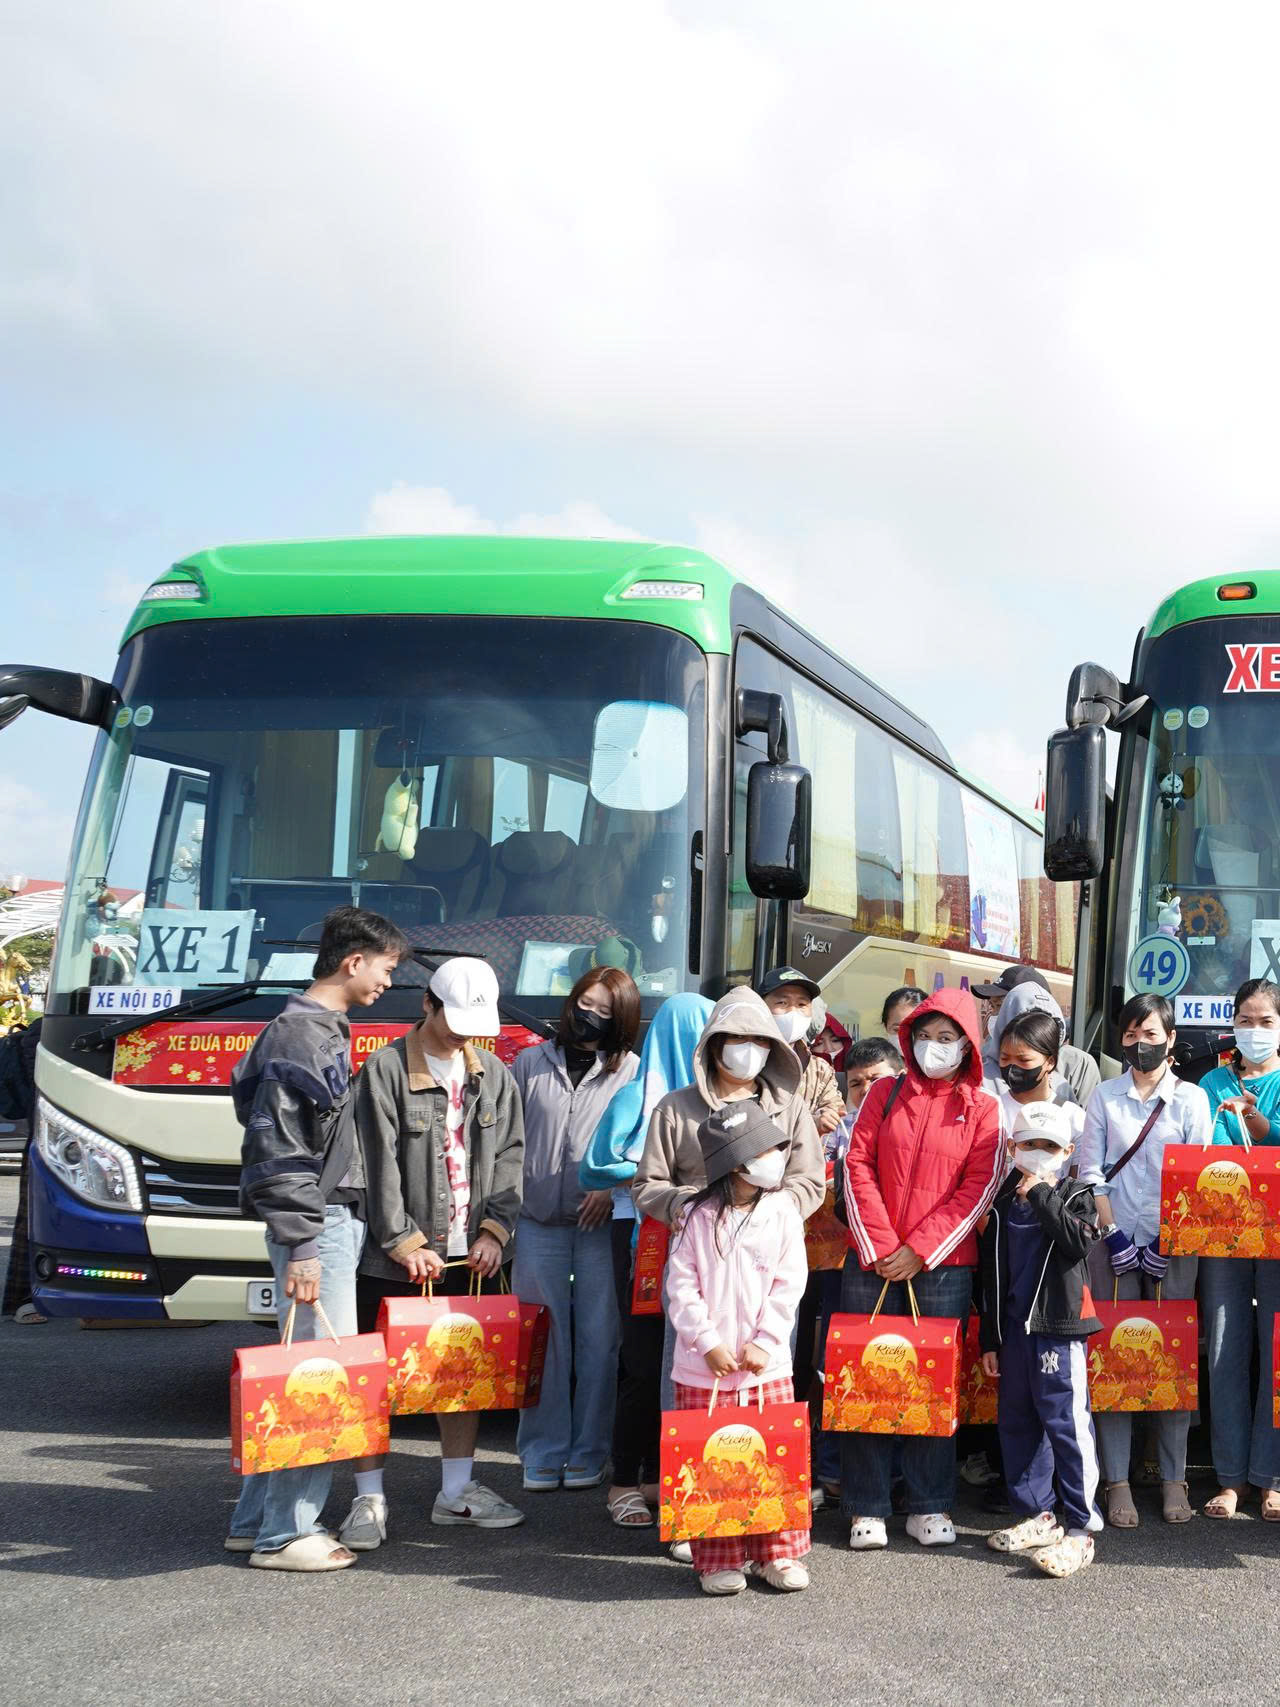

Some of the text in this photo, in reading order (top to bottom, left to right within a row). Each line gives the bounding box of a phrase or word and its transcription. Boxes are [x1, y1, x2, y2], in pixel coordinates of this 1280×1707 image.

[141, 925, 240, 973] XE 1
[1138, 951, 1177, 986] 49
[96, 992, 115, 1008] XE
[120, 989, 146, 1011] NỘI
[1183, 1003, 1203, 1019] XE
[168, 1036, 185, 1051] XE
[190, 1034, 220, 1051] ĐƯA
[471, 1036, 496, 1054] NG
[1207, 1165, 1239, 1187] Richy
[261, 1288, 277, 1307] 9
[1120, 1324, 1152, 1345] Richy
[873, 1342, 906, 1365] Richy
[716, 1430, 752, 1453] Richy
